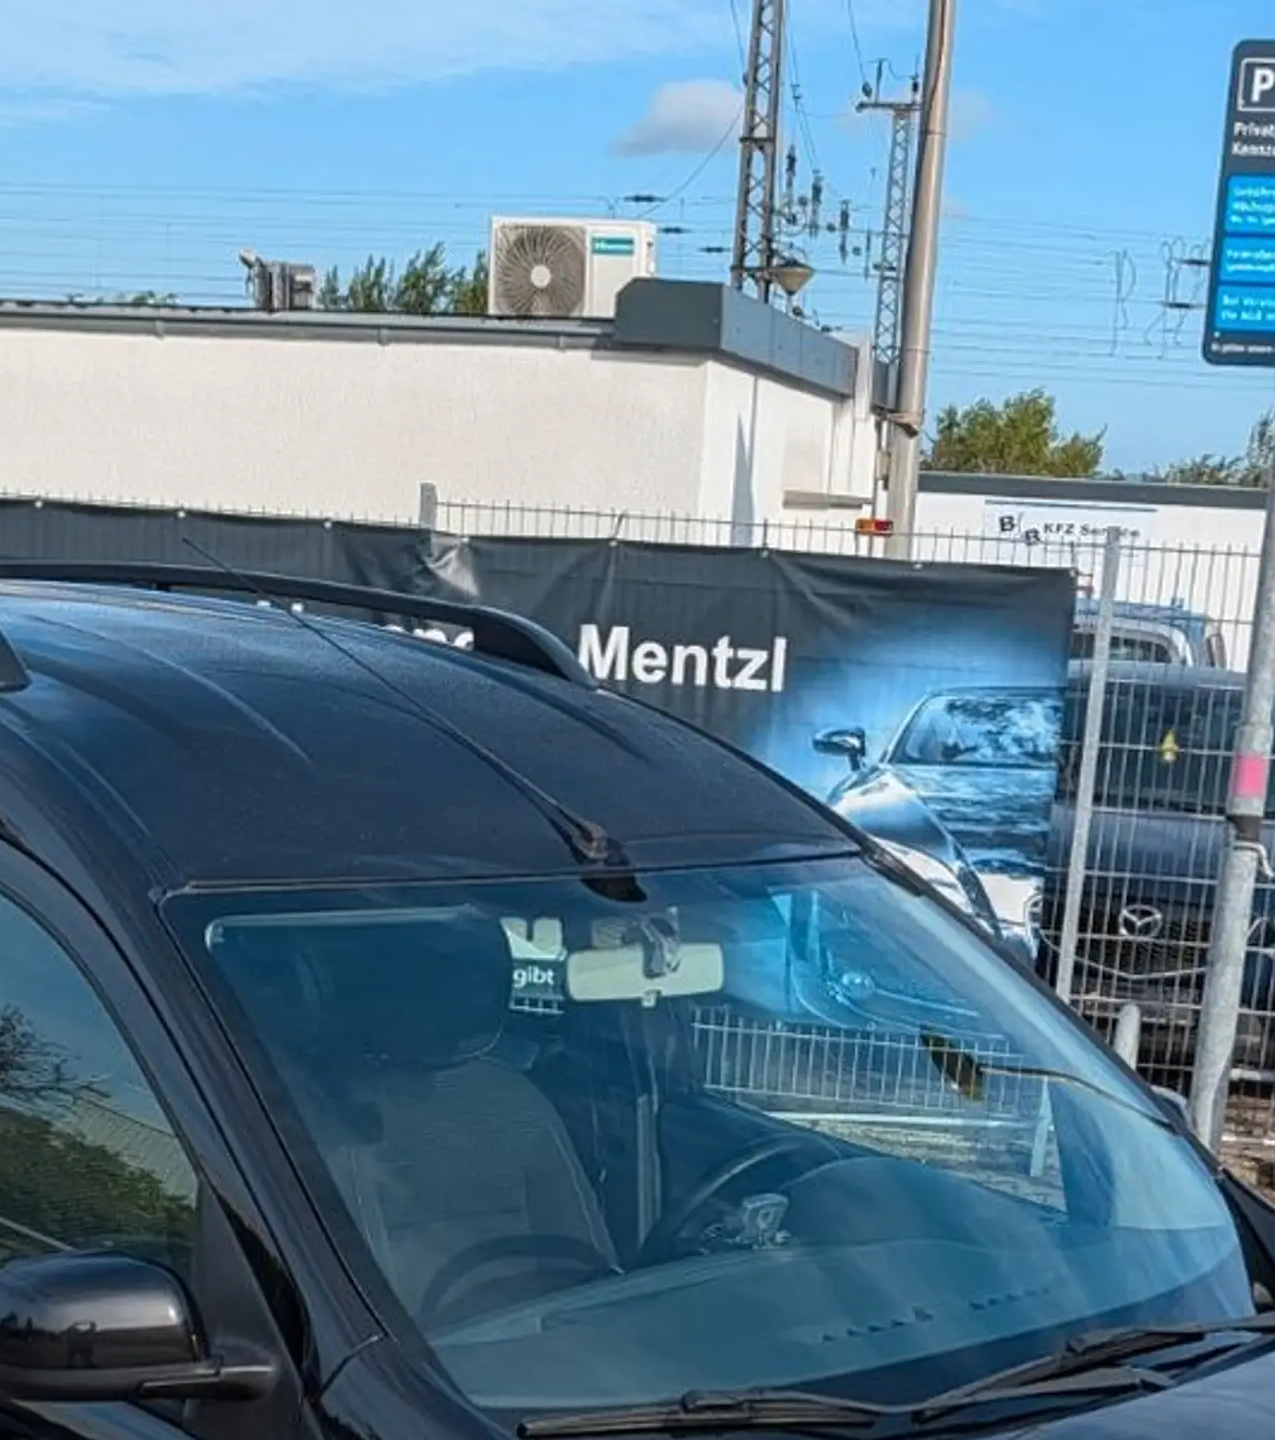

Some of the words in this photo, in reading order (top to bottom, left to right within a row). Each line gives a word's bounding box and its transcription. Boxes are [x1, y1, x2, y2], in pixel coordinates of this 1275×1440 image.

[1252, 66, 1275, 103] P
[1044, 522, 1075, 535] KFZ
[579, 623, 787, 692] Mentzl
[512, 965, 555, 988] gibt
